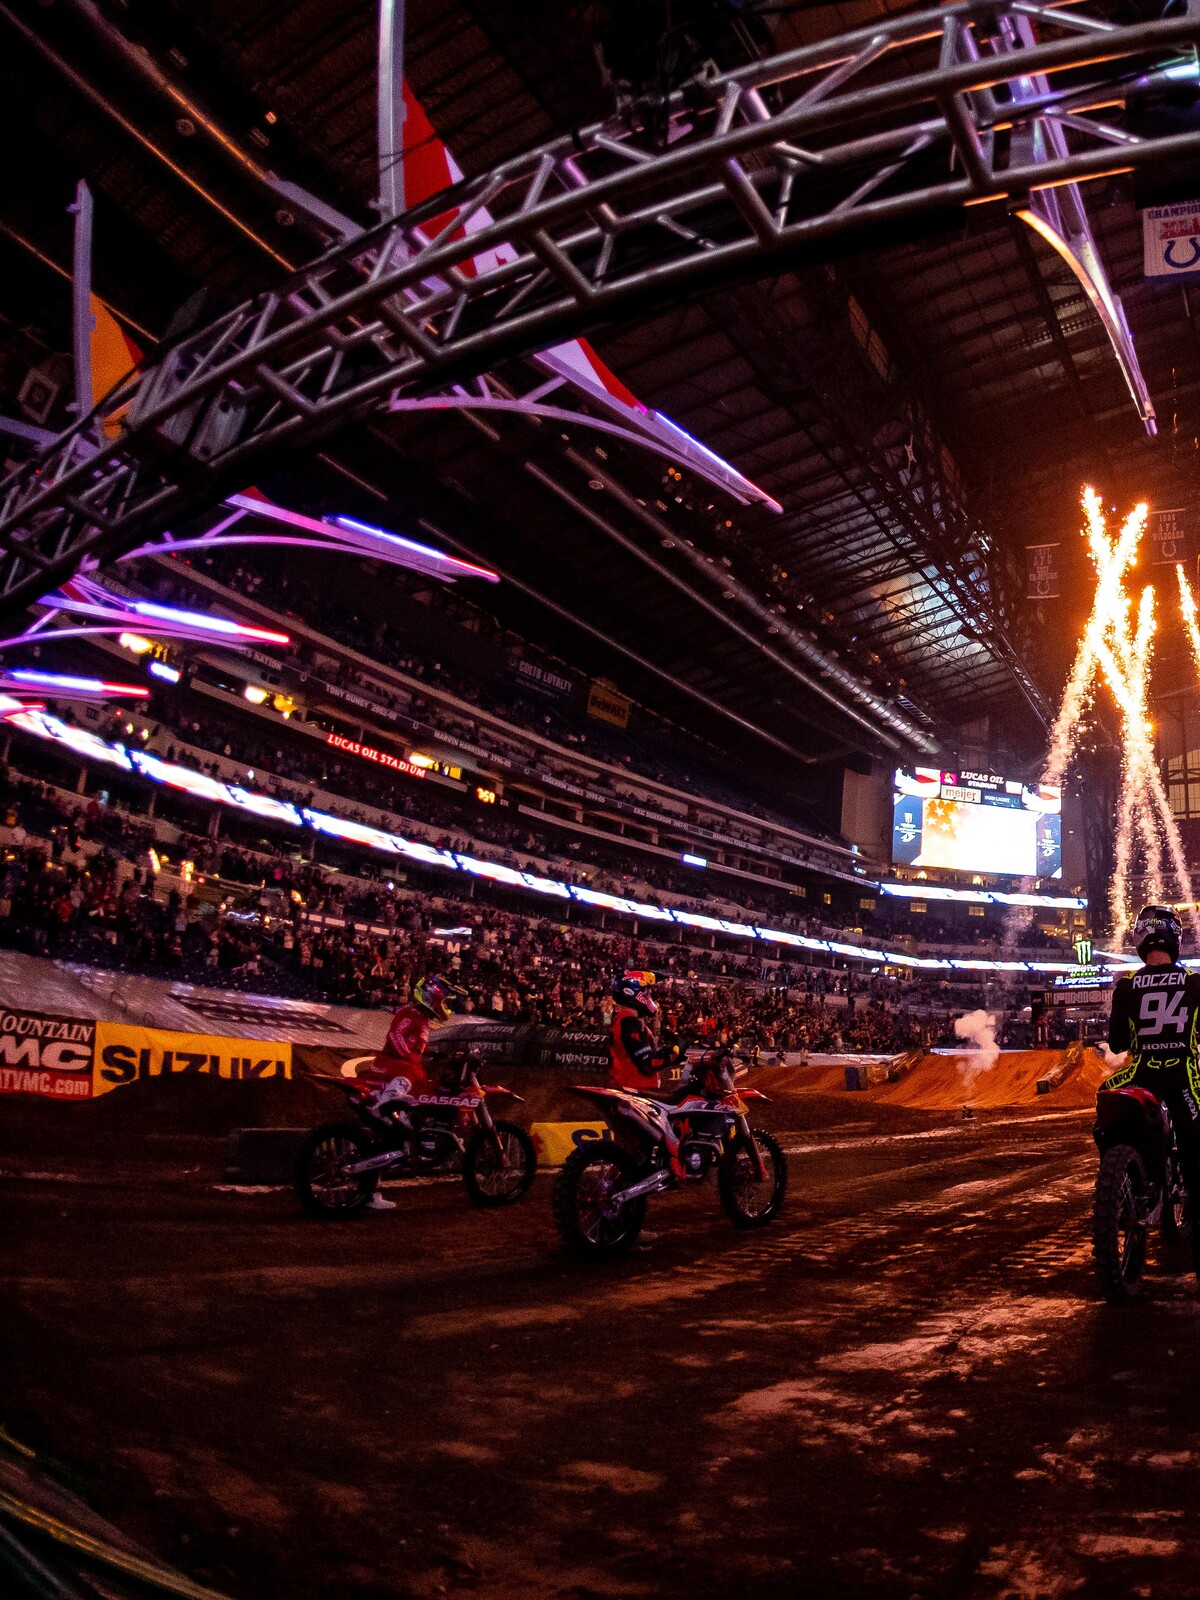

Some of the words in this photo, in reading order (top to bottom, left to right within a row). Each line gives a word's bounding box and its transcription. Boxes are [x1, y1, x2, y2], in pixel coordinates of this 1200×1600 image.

[519, 660, 542, 679] COLTS
[543, 671, 573, 693] LOYALTY
[327, 734, 361, 753] LUCAS
[361, 746, 379, 761] OIL
[380, 753, 427, 779] STADIUM
[961, 771, 989, 782] LUCAS
[989, 775, 1005, 784] OIL
[967, 780, 998, 790] STADIUM
[945, 788, 977, 800] meijer
[1132, 972, 1188, 990] ROCZEN
[1052, 989, 1113, 1005] FINISH
[1137, 990, 1189, 1036] 94
[0, 1010, 93, 1042] OUNTAIN
[1142, 1041, 1186, 1050] HONDA
[101, 1044, 287, 1083] SUZUKI
[418, 1094, 481, 1108] GASGAS
[1182, 1087, 1199, 1121] HONDA
